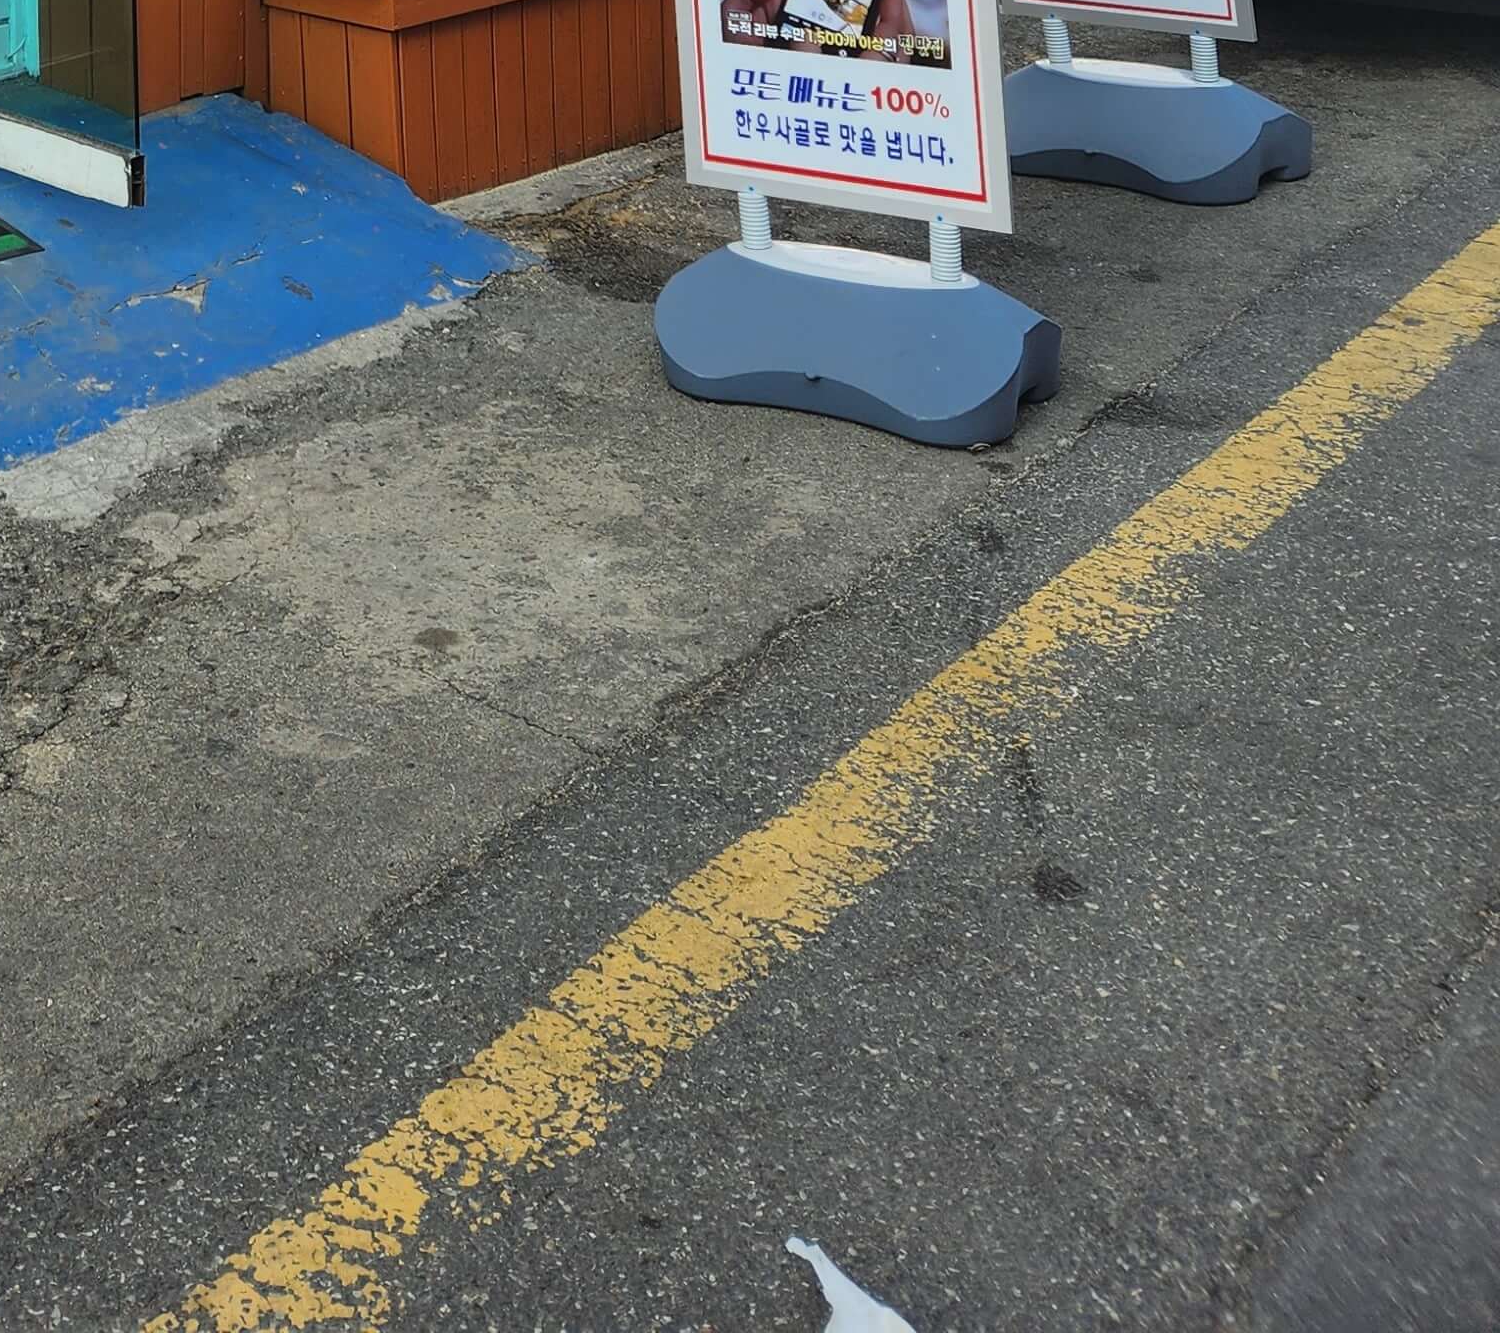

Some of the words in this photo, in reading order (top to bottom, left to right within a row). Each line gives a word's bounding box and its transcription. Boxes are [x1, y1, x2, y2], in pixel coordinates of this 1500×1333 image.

[731, 68, 783, 100] 모든
[787, 75, 868, 112] 메뉴는
[869, 85, 951, 120] 100%
[838, 124, 878, 158] 맛을
[885, 130, 955, 167] 냅니다.
